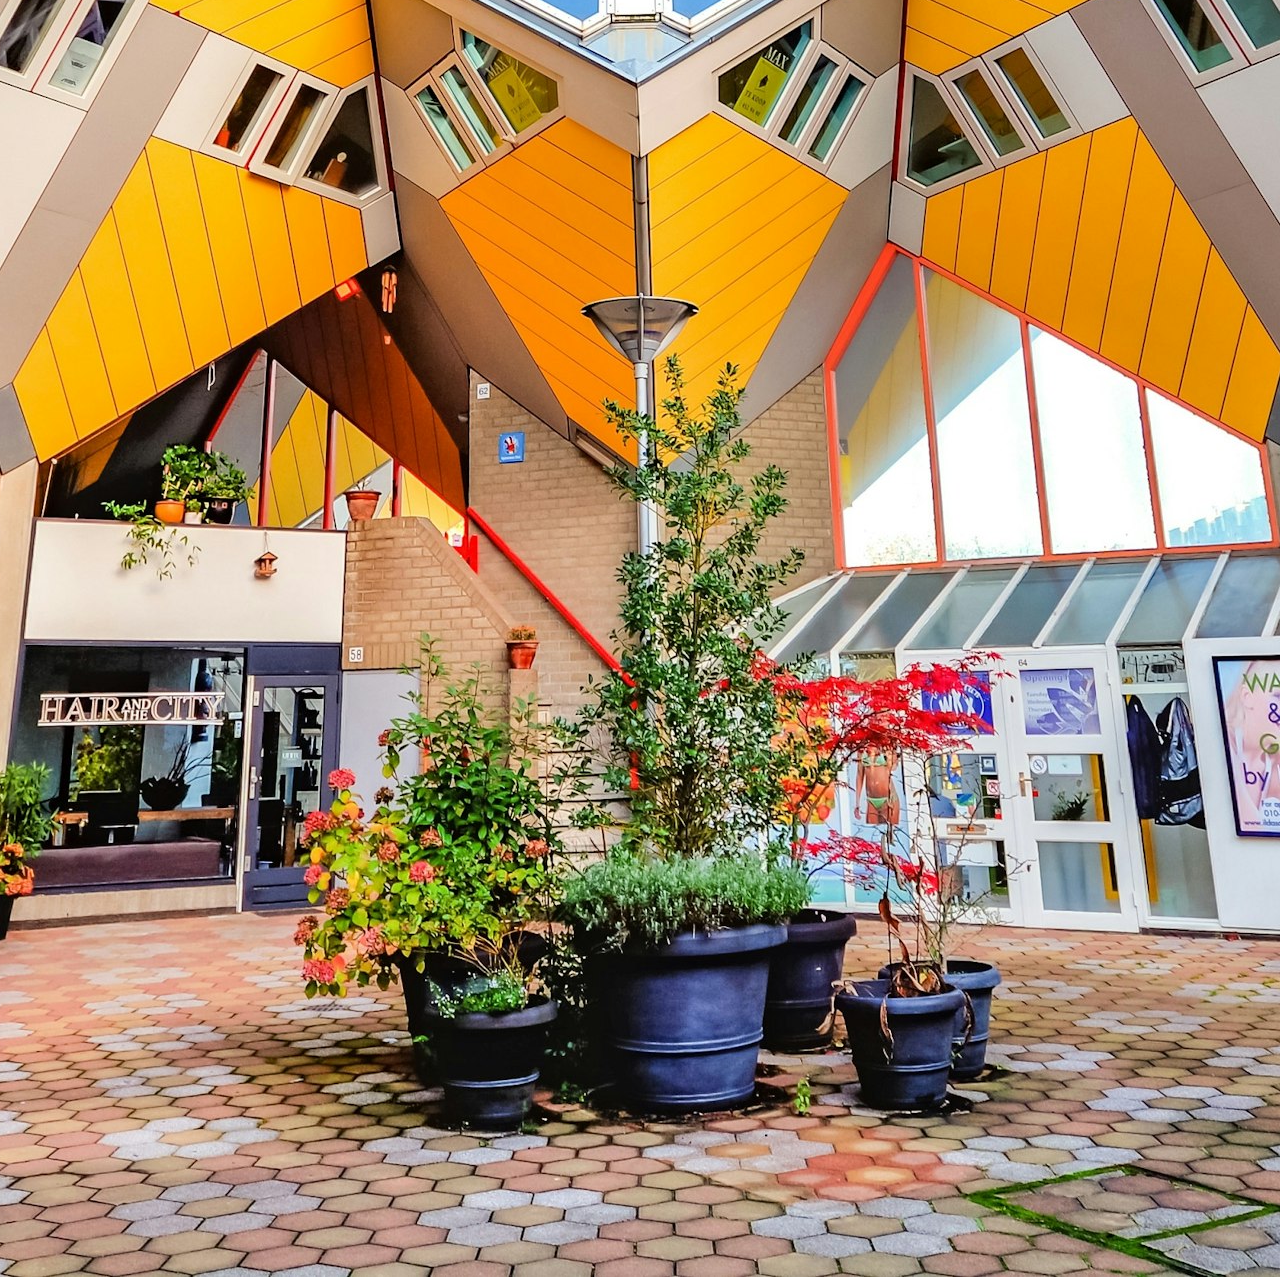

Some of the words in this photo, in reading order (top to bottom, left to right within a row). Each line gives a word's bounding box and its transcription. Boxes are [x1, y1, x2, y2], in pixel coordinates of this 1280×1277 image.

[764, 46, 789, 70] MAX
[478, 387, 488, 396] 62
[350, 649, 362, 661] 58
[1018, 658, 1028, 667] 64
[1024, 674, 1063, 684] Opening
[38, 696, 123, 723] HAIR
[121, 698, 151, 710] AND
[150, 695, 225, 721] CITY
[121, 709, 149, 721] THE
[1243, 763, 1269, 792] by
